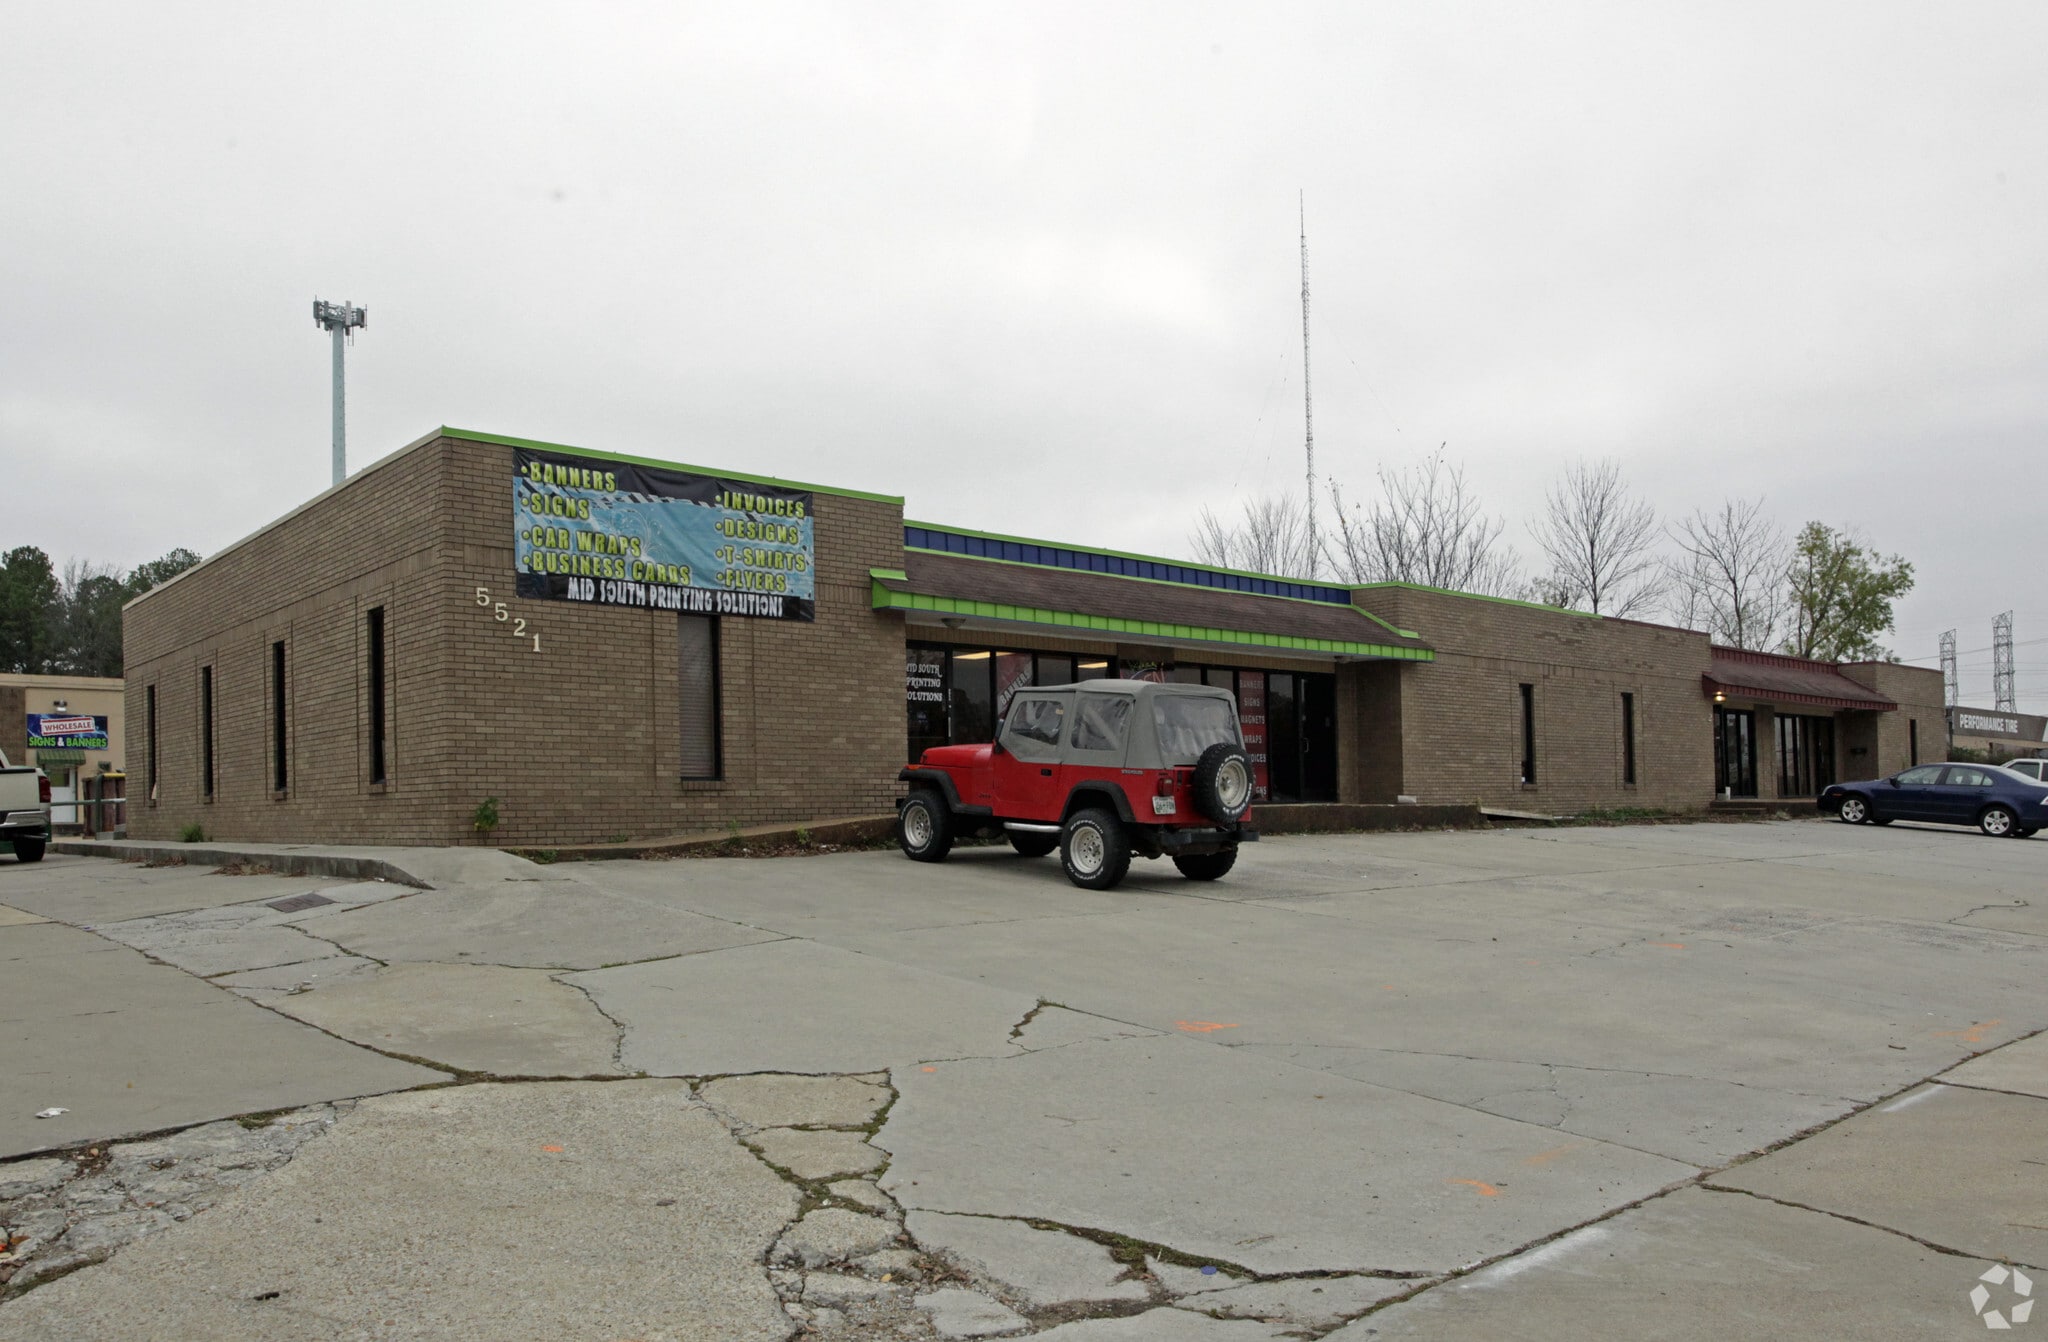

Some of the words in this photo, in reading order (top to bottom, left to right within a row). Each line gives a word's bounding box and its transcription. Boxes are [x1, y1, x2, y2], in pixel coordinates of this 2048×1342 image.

[529, 461, 616, 492] BANNERS
[530, 493, 590, 520] SIGNS
[724, 491, 805, 519] INVOICES
[531, 525, 570, 550] CAR
[576, 530, 641, 557] WRAPS
[724, 518, 799, 545] DESIGNS
[533, 551, 626, 579] BUSINESS
[631, 560, 691, 586] CARDS
[725, 545, 806, 572] T-SHIRTS
[725, 569, 786, 592] FLYERS
[567, 576, 595, 601] MID
[600, 580, 646, 606] SOUTH
[650, 586, 713, 612] PRINTING
[717, 591, 783, 617] SOLUTIONS
[918, 664, 943, 678] SOUTH
[906, 677, 941, 689] PRINTING
[907, 691, 943, 702] OLUTIONS
[1243, 697, 1260, 707] SIGNS
[44, 722, 92, 732] WHOLESALE
[1960, 714, 2004, 732] PERFORMANCE
[2005, 719, 2018, 733] TIRE
[29, 737, 56, 747] SIGNS
[57, 737, 65, 747] &
[66, 737, 107, 748] BANNERS
[1250, 754, 1267, 763] OICES
